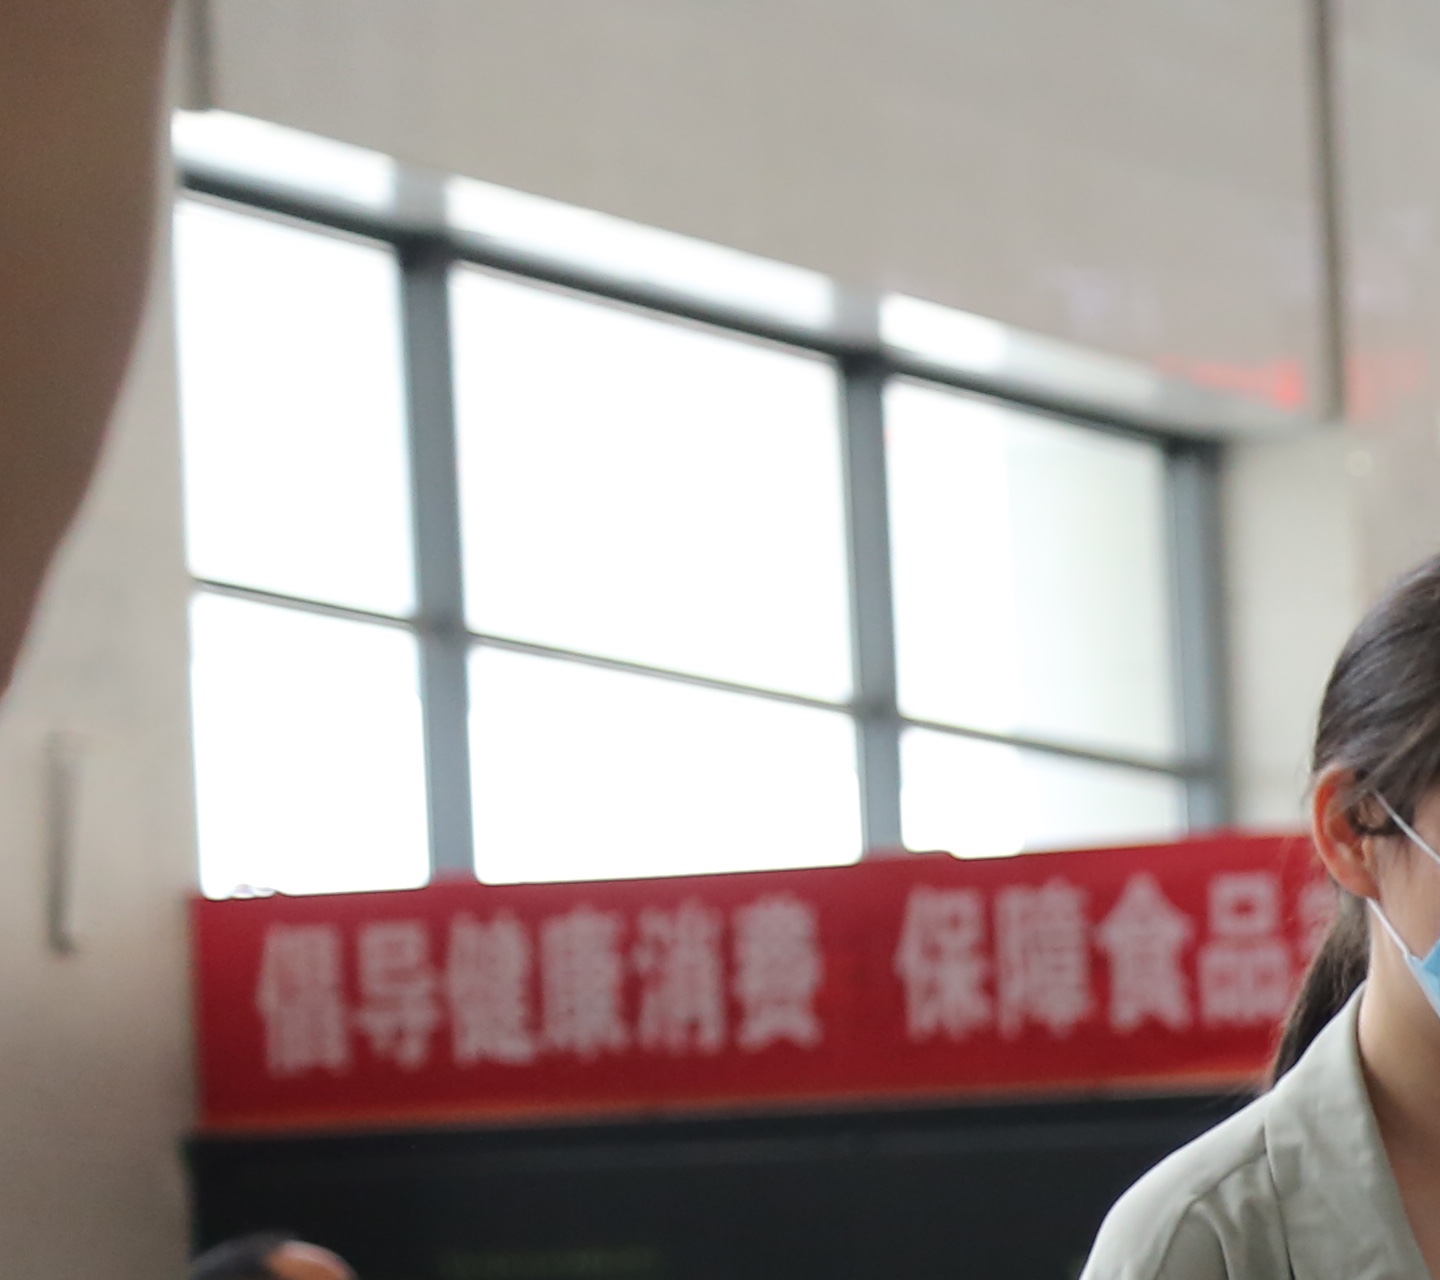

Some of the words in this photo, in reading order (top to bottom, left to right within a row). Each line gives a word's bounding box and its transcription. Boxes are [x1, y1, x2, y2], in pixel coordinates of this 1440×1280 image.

[256, 892, 824, 1076] 倡导健康消费
